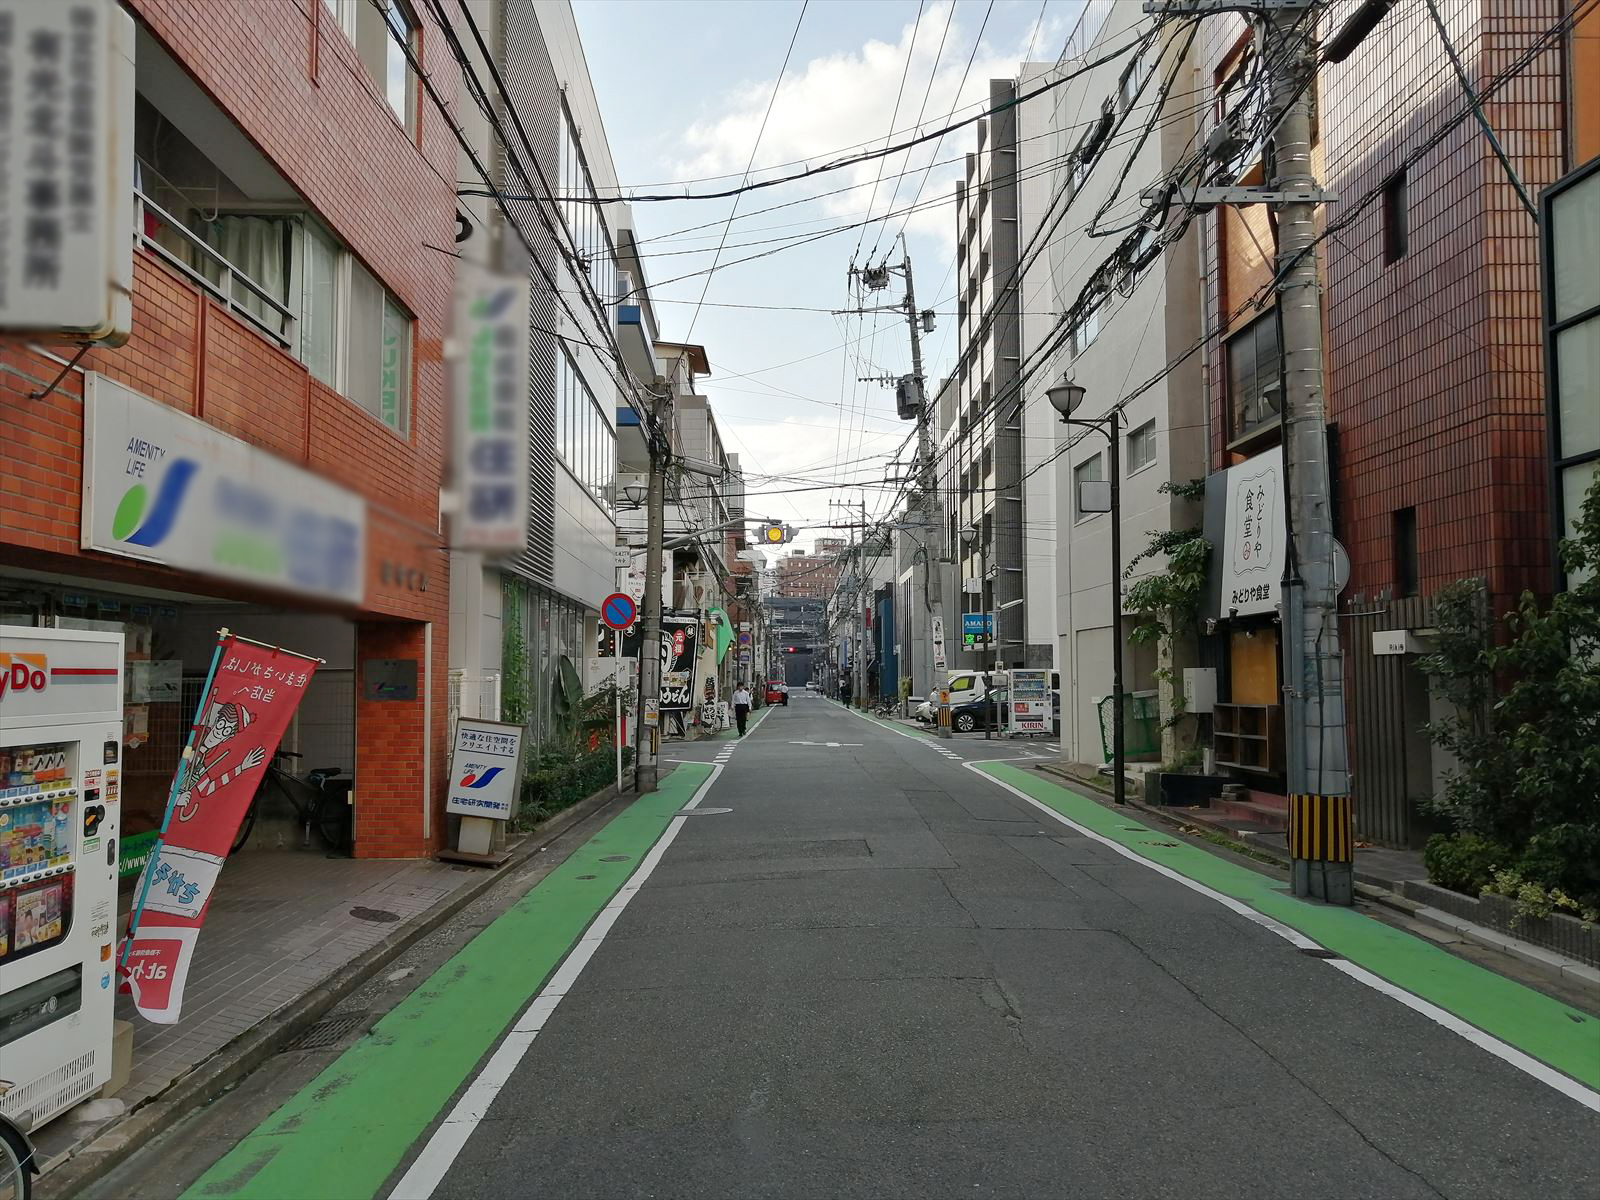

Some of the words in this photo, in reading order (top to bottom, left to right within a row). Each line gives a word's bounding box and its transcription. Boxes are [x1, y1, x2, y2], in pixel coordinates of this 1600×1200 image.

[126, 436, 165, 461] AMENITY
[126, 458, 145, 478] LIFE
[1243, 489, 1255, 539] 食堂
[1254, 485, 1265, 559] みどりや
[1231, 583, 1270, 604] みどりや食堂
[461, 741, 515, 754] クリエイトする
